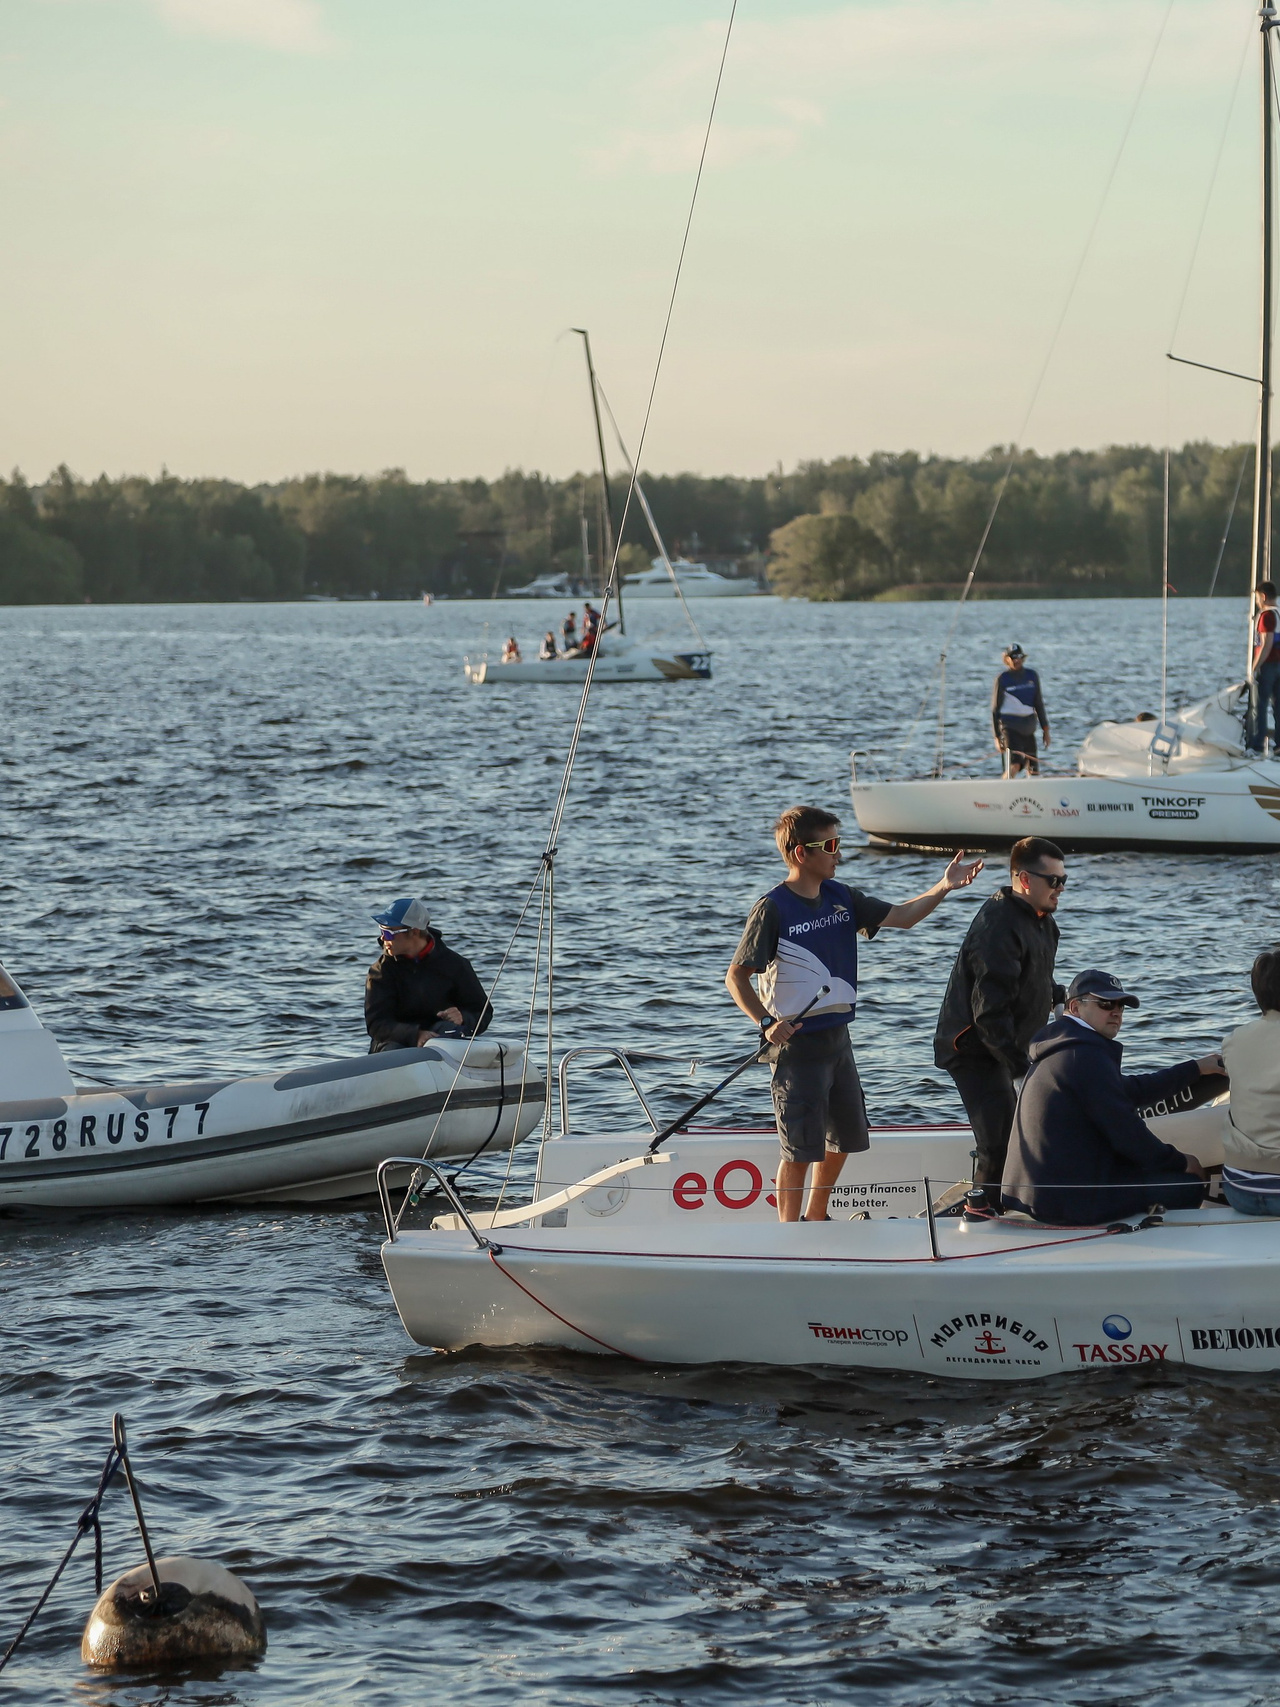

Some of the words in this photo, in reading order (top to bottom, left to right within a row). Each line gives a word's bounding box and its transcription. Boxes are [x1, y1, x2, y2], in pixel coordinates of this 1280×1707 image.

[1141, 797, 1206, 807] TINKOFF
[1052, 808, 1080, 817] TASSAY
[1151, 810, 1198, 819] PREMIUM
[788, 911, 850, 937] PROYACHTING
[869, 1184, 917, 1194] finances
[831, 1198, 850, 1208] the
[852, 1198, 889, 1208] better.
[930, 1313, 1049, 1351] МОРПРИБОР
[1072, 1344, 1169, 1363] TASSAY
